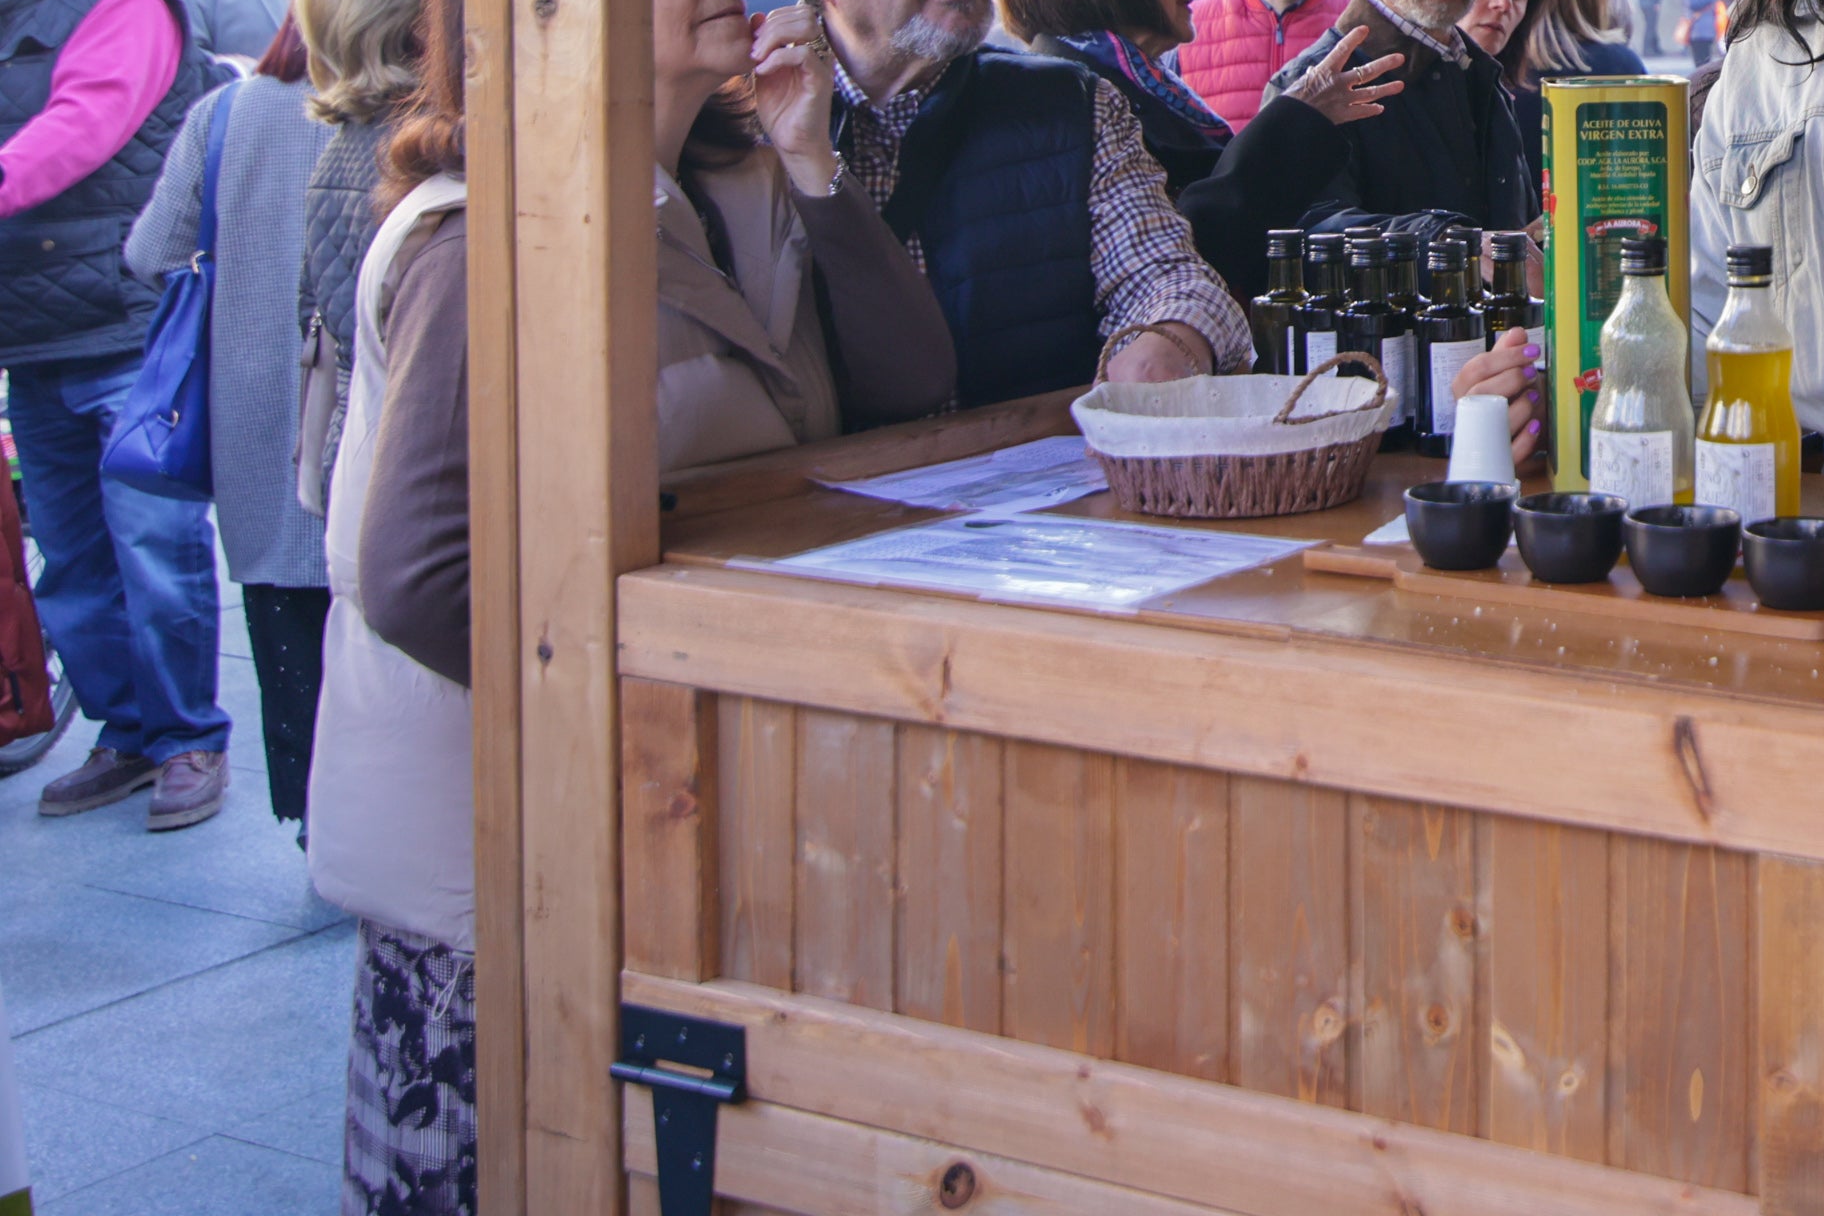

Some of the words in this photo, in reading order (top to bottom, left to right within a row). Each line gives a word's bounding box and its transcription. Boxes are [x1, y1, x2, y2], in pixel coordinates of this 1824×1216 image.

[1582, 119, 1616, 129] ACEITE
[1616, 119, 1631, 128] DE
[1632, 118, 1662, 128] OLIVA
[1580, 129, 1626, 141] VIRGEN
[1628, 129, 1665, 140] EXTRA
